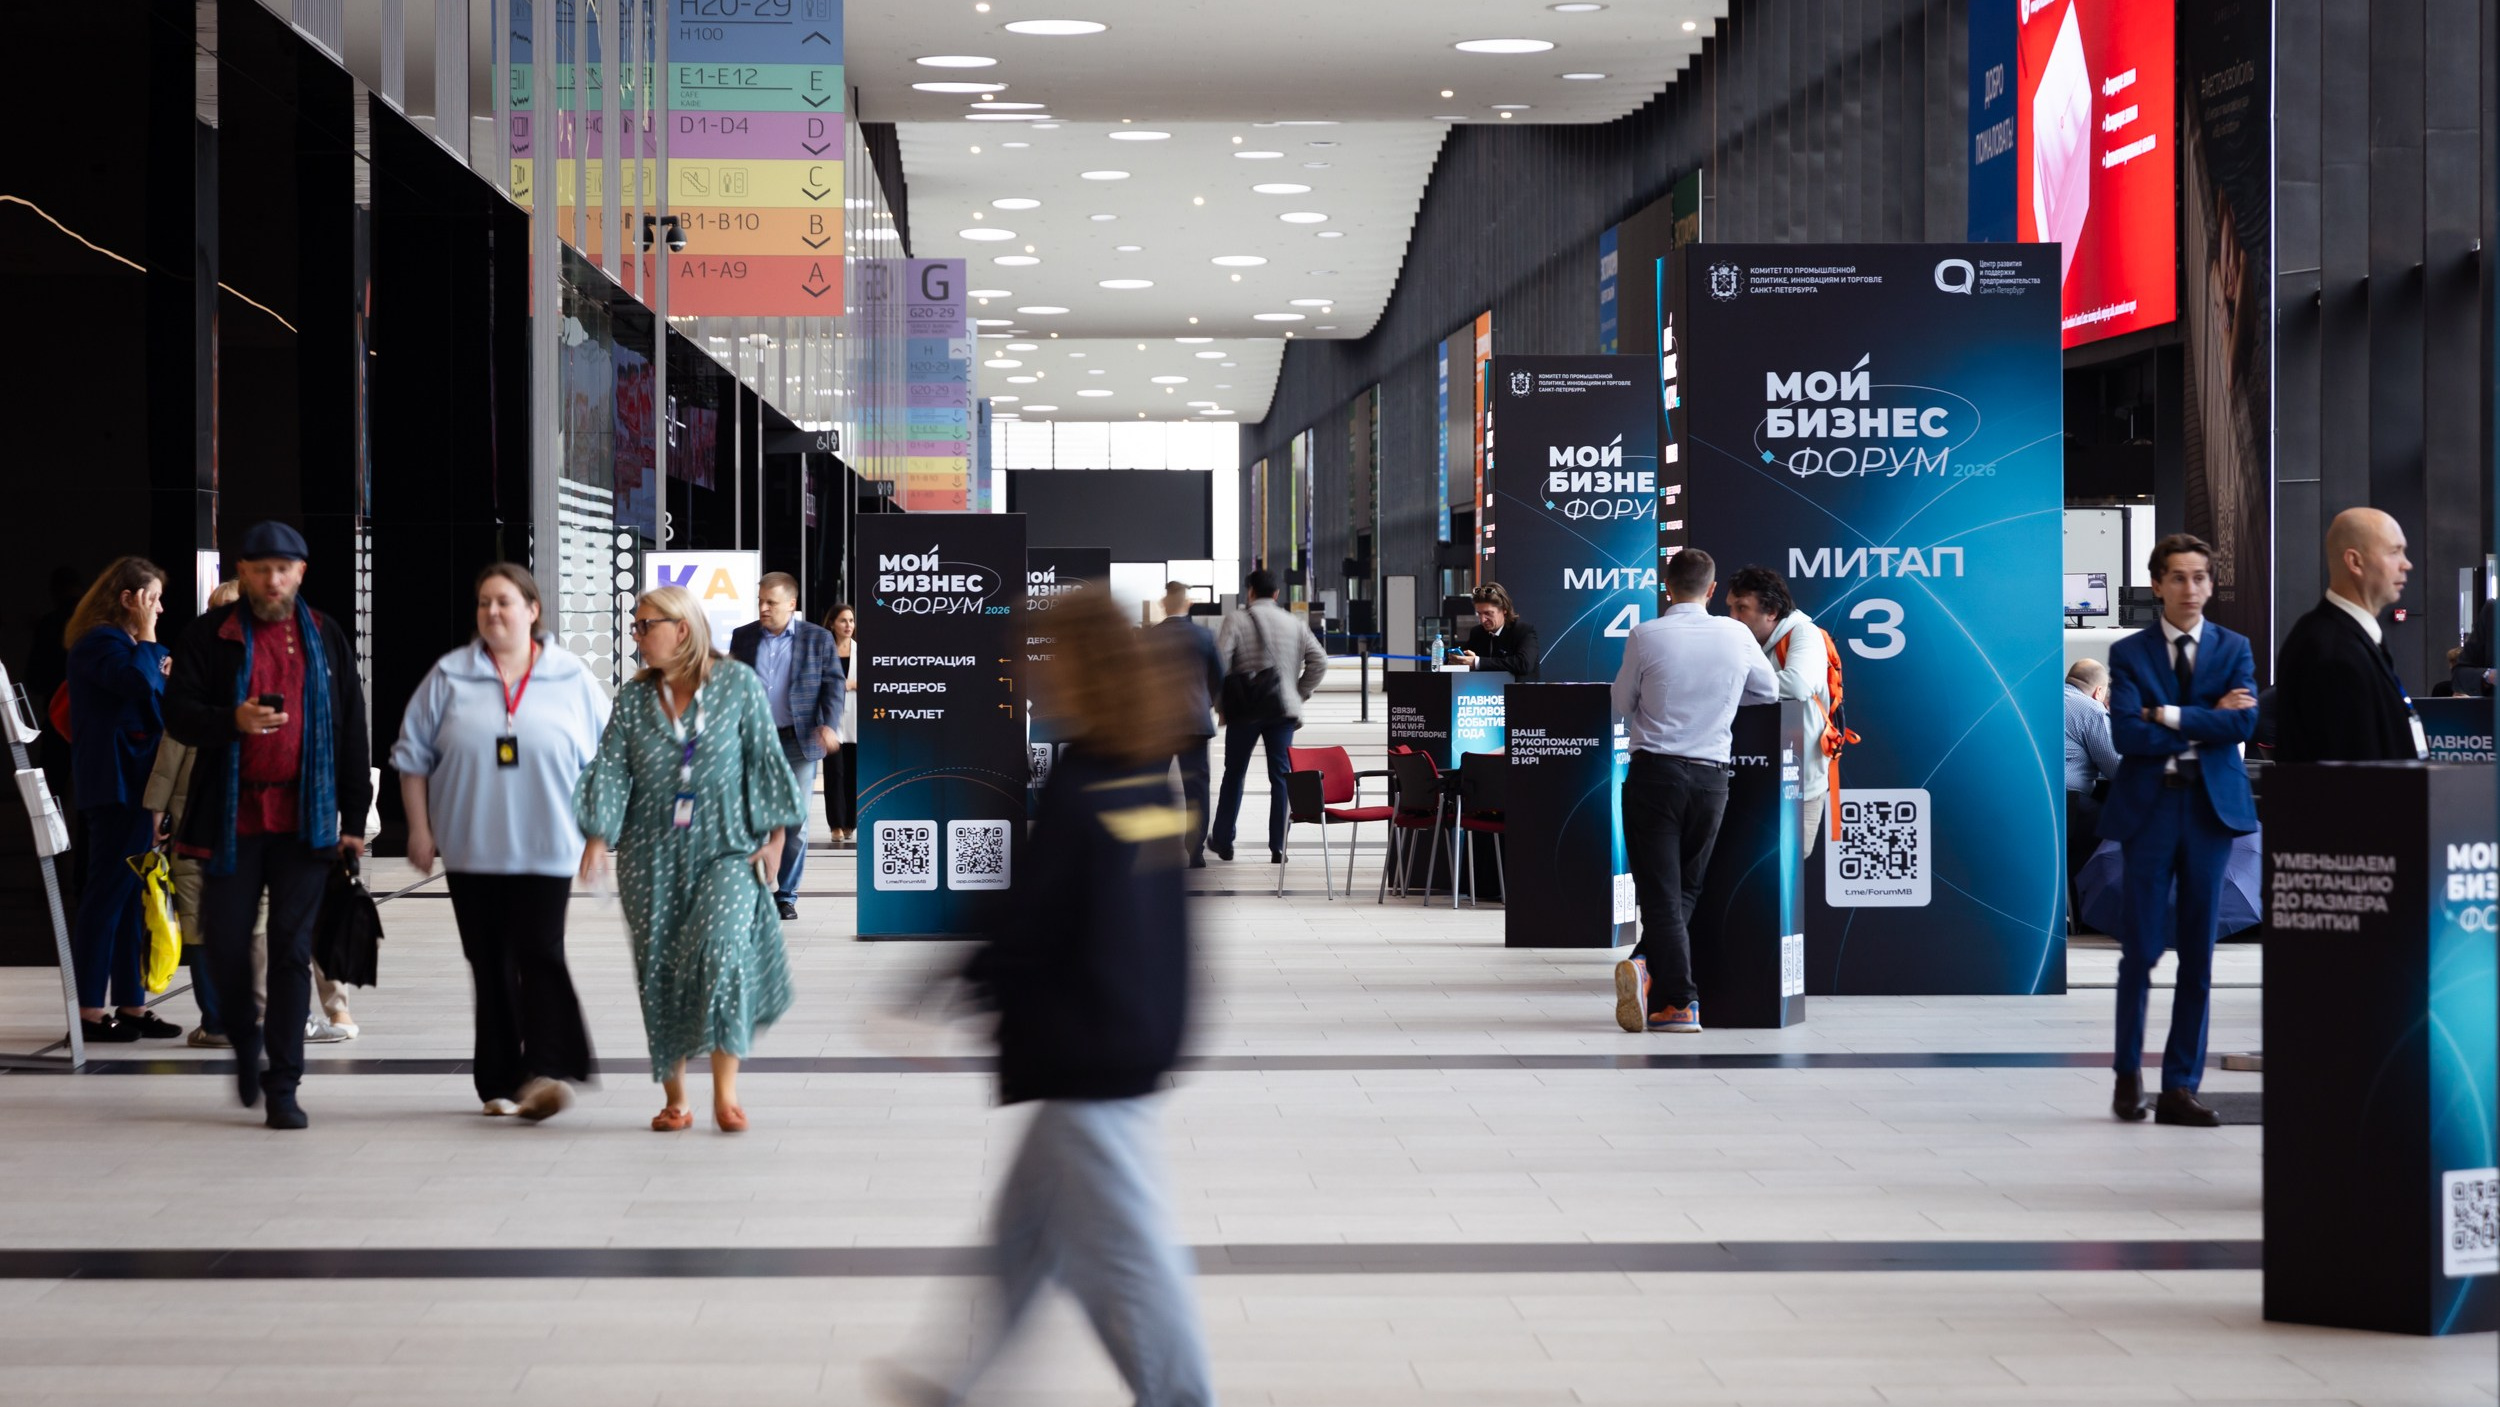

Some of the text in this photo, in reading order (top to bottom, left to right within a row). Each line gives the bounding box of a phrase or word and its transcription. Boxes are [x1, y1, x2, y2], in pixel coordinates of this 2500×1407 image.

[680, 27, 724, 41] H100
[680, 67, 758, 86] E1-E12
[810, 70, 823, 91] E
[1984, 63, 2005, 110] ДОБРО
[680, 116, 749, 134] D1-D4
[807, 117, 825, 139] D
[809, 165, 823, 187] C
[680, 212, 760, 231] B1-B10
[809, 214, 824, 235] B
[680, 261, 748, 279] A1-A9
[808, 262, 825, 283] A
[1794, 265, 1856, 274] ПРОМЫШЛЕННОЙ
[1979, 260, 2023, 269] Центр развития
[1984, 269, 2016, 278] поддержки
[921, 263, 950, 301] G
[1750, 276, 1883, 285] ПОЛИТИКЕ, ИННОВАЦИЯМ И ТОРГОВЛЕ
[1979, 277, 2041, 286] предпринимательства
[1750, 286, 1818, 294] САНКТ-ПЕТЕРБУРГА
[1979, 286, 2026, 296] Санкт-Петербург
[909, 307, 955, 318] G20-29
[924, 345, 933, 356] H
[910, 361, 950, 371] H20-29
[1766, 352, 1870, 401] МОЙ
[910, 385, 949, 395] G20-29
[1766, 407, 1949, 438] БИЗНЕС
[1549, 433, 1622, 467] МОЙ
[1788, 446, 1997, 478] ФОРУМ 2026
[1549, 471, 1655, 493] БИЗНЕ
[1564, 499, 1657, 520] ФОРУ
[879, 544, 939, 572] МОЙ
[1788, 547, 1964, 579] МИТАП
[879, 574, 984, 592] БИЗНЕС
[891, 596, 1011, 615] ФОРУМ 2026
[1604, 604, 1640, 637] 4
[1848, 598, 1906, 660] 3
[872, 655, 976, 668] РЕГИСТРАЦИЯ
[873, 682, 947, 694] ГАРДЕРОБ
[1457, 695, 1504, 705] ГЛАВНОЕ
[888, 709, 945, 719] ТУАЛЕТ
[1391, 715, 1426, 723] КРЕПКИЕ,
[1457, 706, 1505, 717] ДЕЛОВОЕ
[1457, 717, 1505, 727] СОБЫТИЕ
[1457, 728, 1486, 739] ГОДА
[1511, 728, 1546, 737] ВАШЕ
[1511, 738, 1599, 747] РУКОПОЖАТИЕ
[1511, 747, 1582, 756] ЗАСЧИТАНО
[1511, 757, 1539, 765] В KPI
[1738, 756, 1769, 767] ТУТ,
[2272, 852, 2396, 873] УМЕНЬШАЕМ
[1845, 887, 1912, 896] t.me/ForumMB
[2272, 872, 2394, 893] ДИСТАНЦИЮ
[2272, 892, 2389, 913] ДО РАЗМЕРА
[2272, 911, 2360, 931] ВИЗИТКИ
